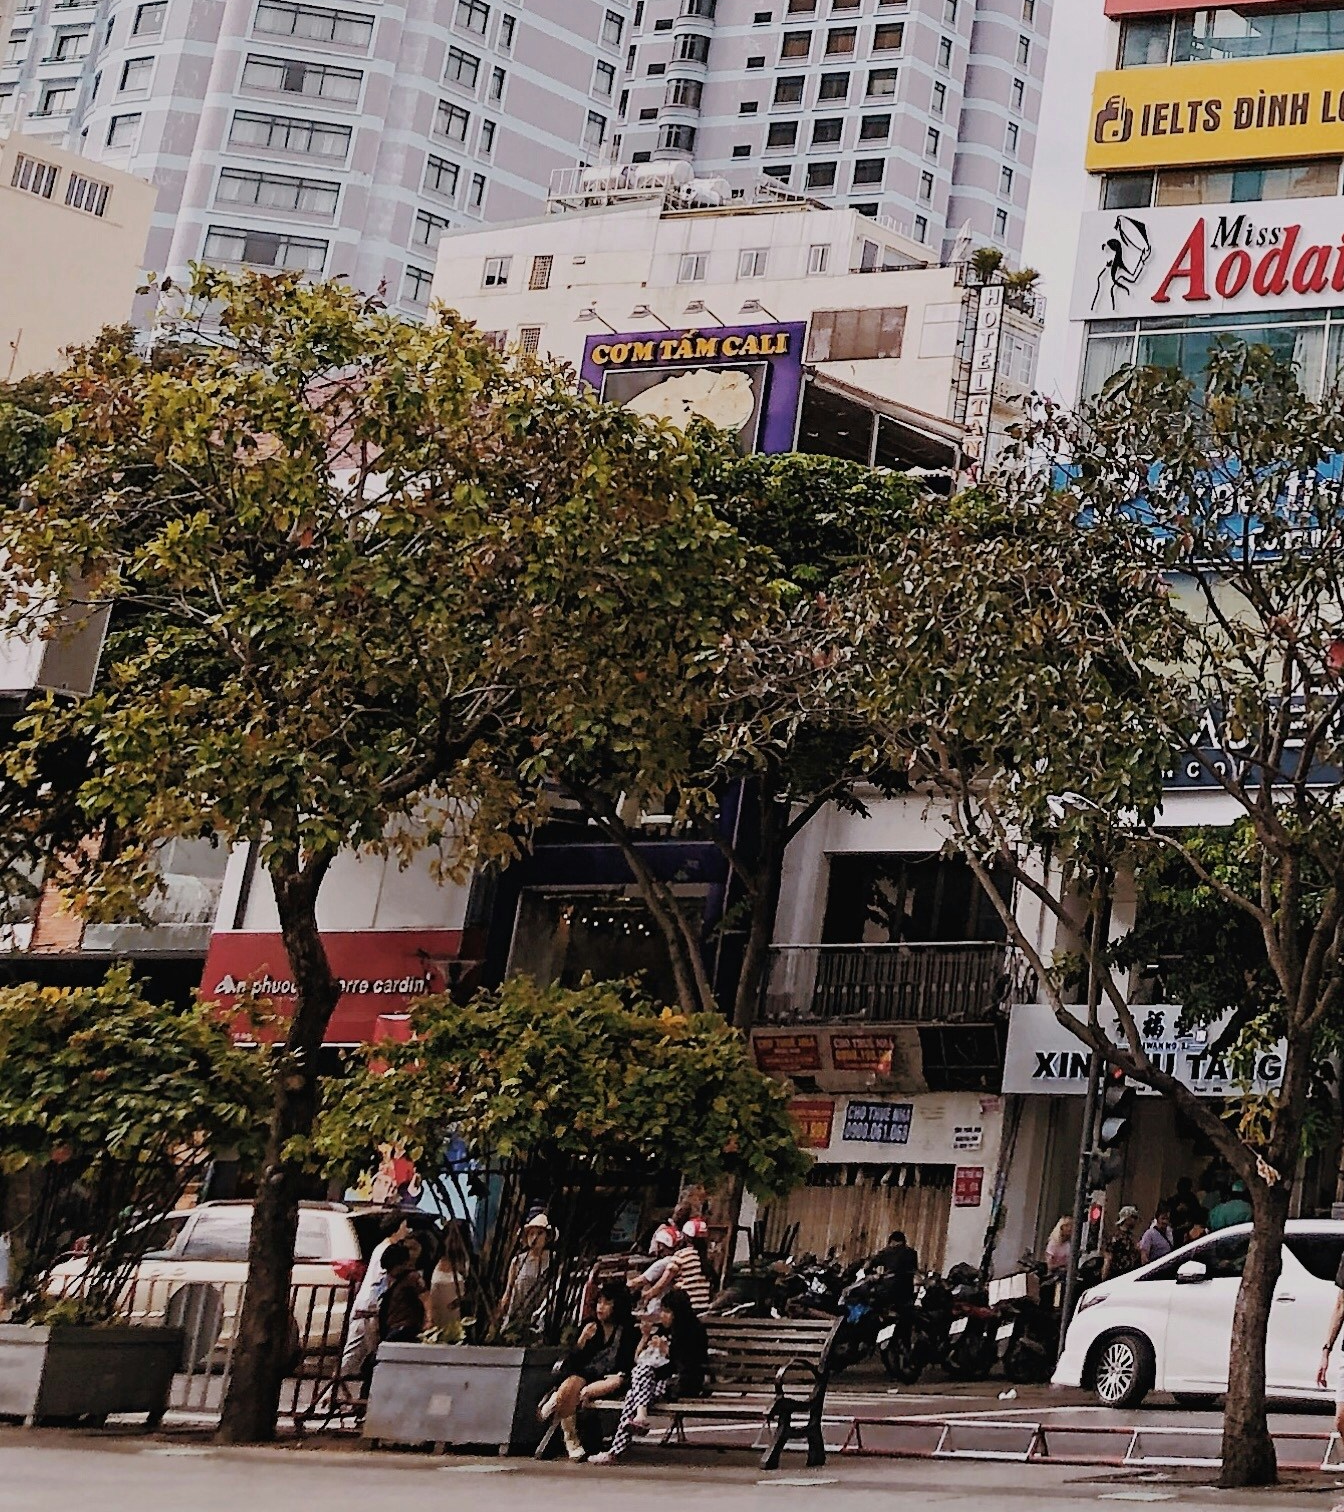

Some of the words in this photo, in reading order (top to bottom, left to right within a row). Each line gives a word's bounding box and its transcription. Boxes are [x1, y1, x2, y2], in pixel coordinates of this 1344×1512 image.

[1141, 95, 1221, 136] IELTS
[1234, 90, 1308, 130] ĐÌNH
[1211, 215, 1281, 249] Miss
[591, 341, 656, 365] CƠM
[660, 330, 718, 360] TẤM
[721, 333, 790, 357] CALI
[976, 287, 999, 391] HOTEL
[214, 974, 245, 995] An
